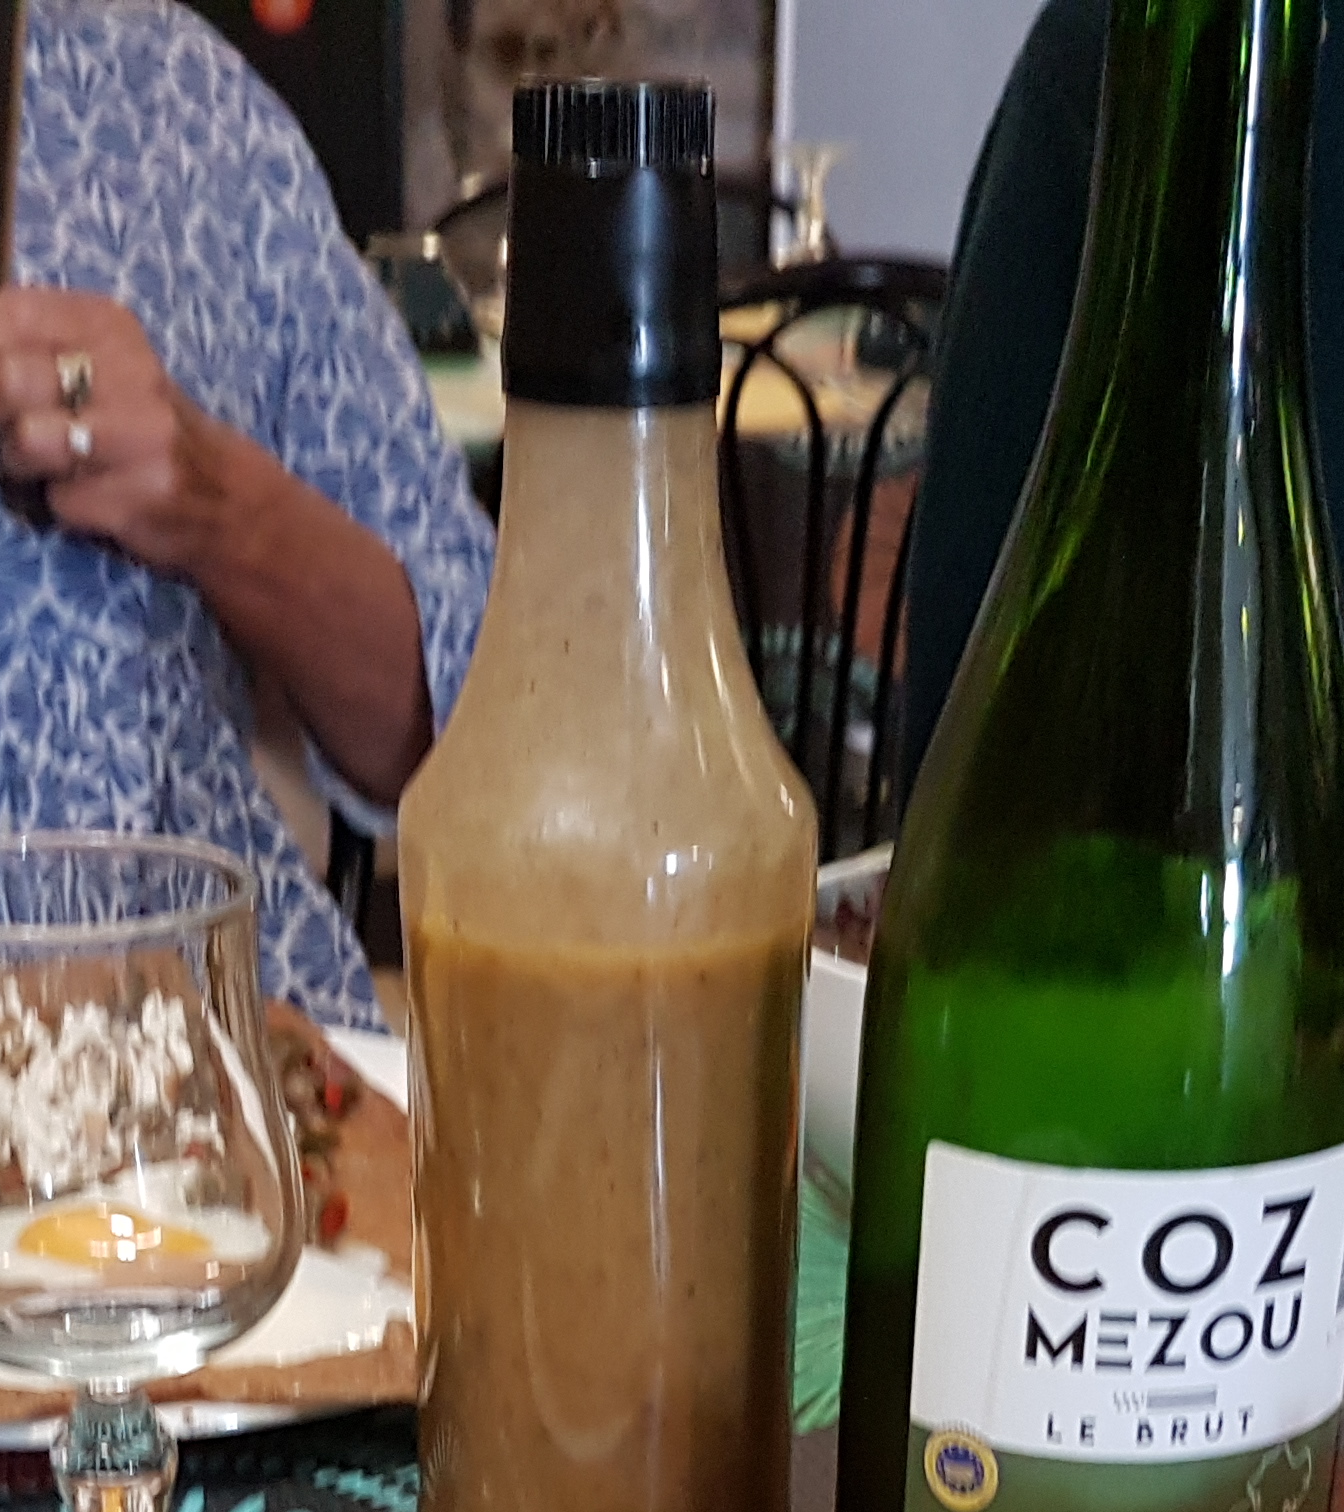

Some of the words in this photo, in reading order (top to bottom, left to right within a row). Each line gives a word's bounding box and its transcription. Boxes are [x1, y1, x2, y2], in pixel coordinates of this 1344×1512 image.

[1030, 1191, 1316, 1296] COZ
[1024, 1292, 1304, 1372] MEZOU
[1046, 1411, 1095, 1446] LE
[1136, 1403, 1254, 1446] BRUT
